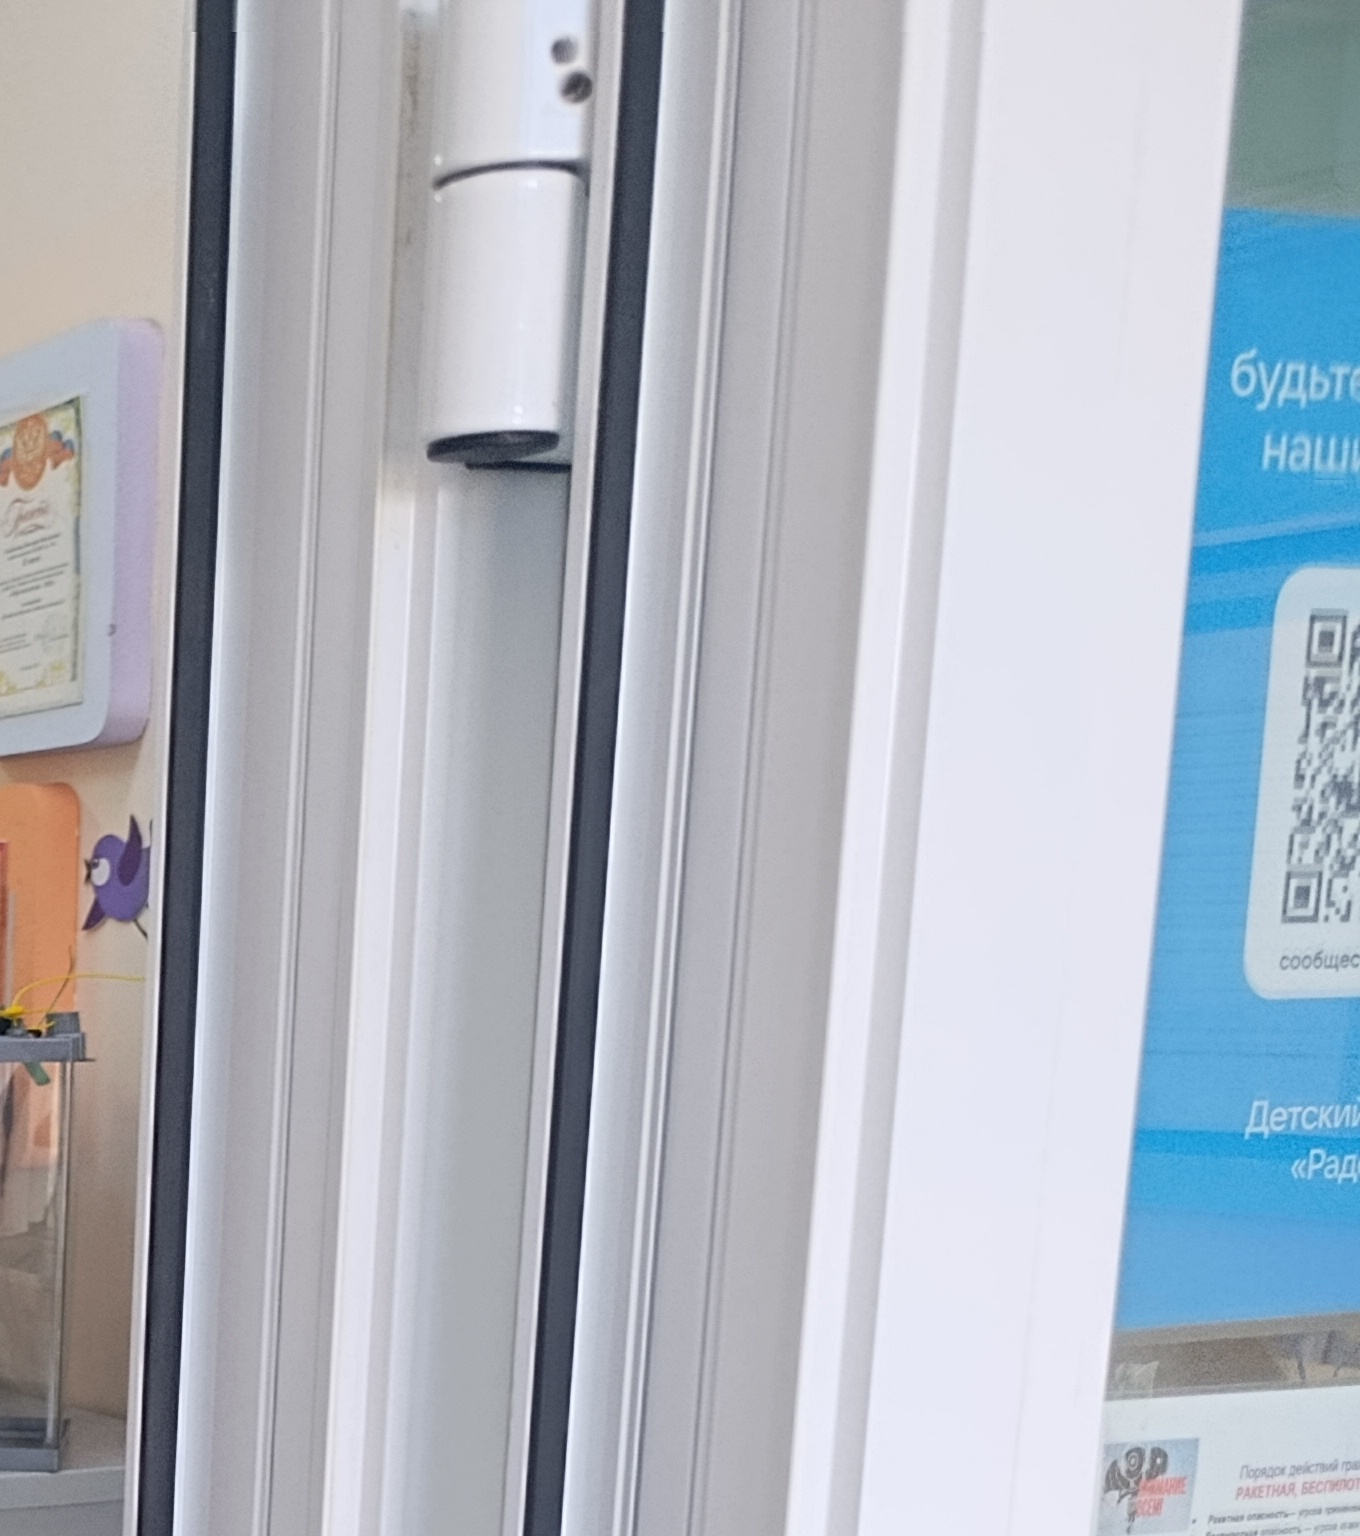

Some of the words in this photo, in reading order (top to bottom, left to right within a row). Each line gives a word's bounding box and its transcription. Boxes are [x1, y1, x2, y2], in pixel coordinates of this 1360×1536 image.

[1290, 1148, 1360, 1185] «Рад
[1240, 1465, 1285, 1481] Порядок
[1288, 1459, 1338, 1477] действий
[1236, 1483, 1297, 1499] РАКЕТНАЯ,
